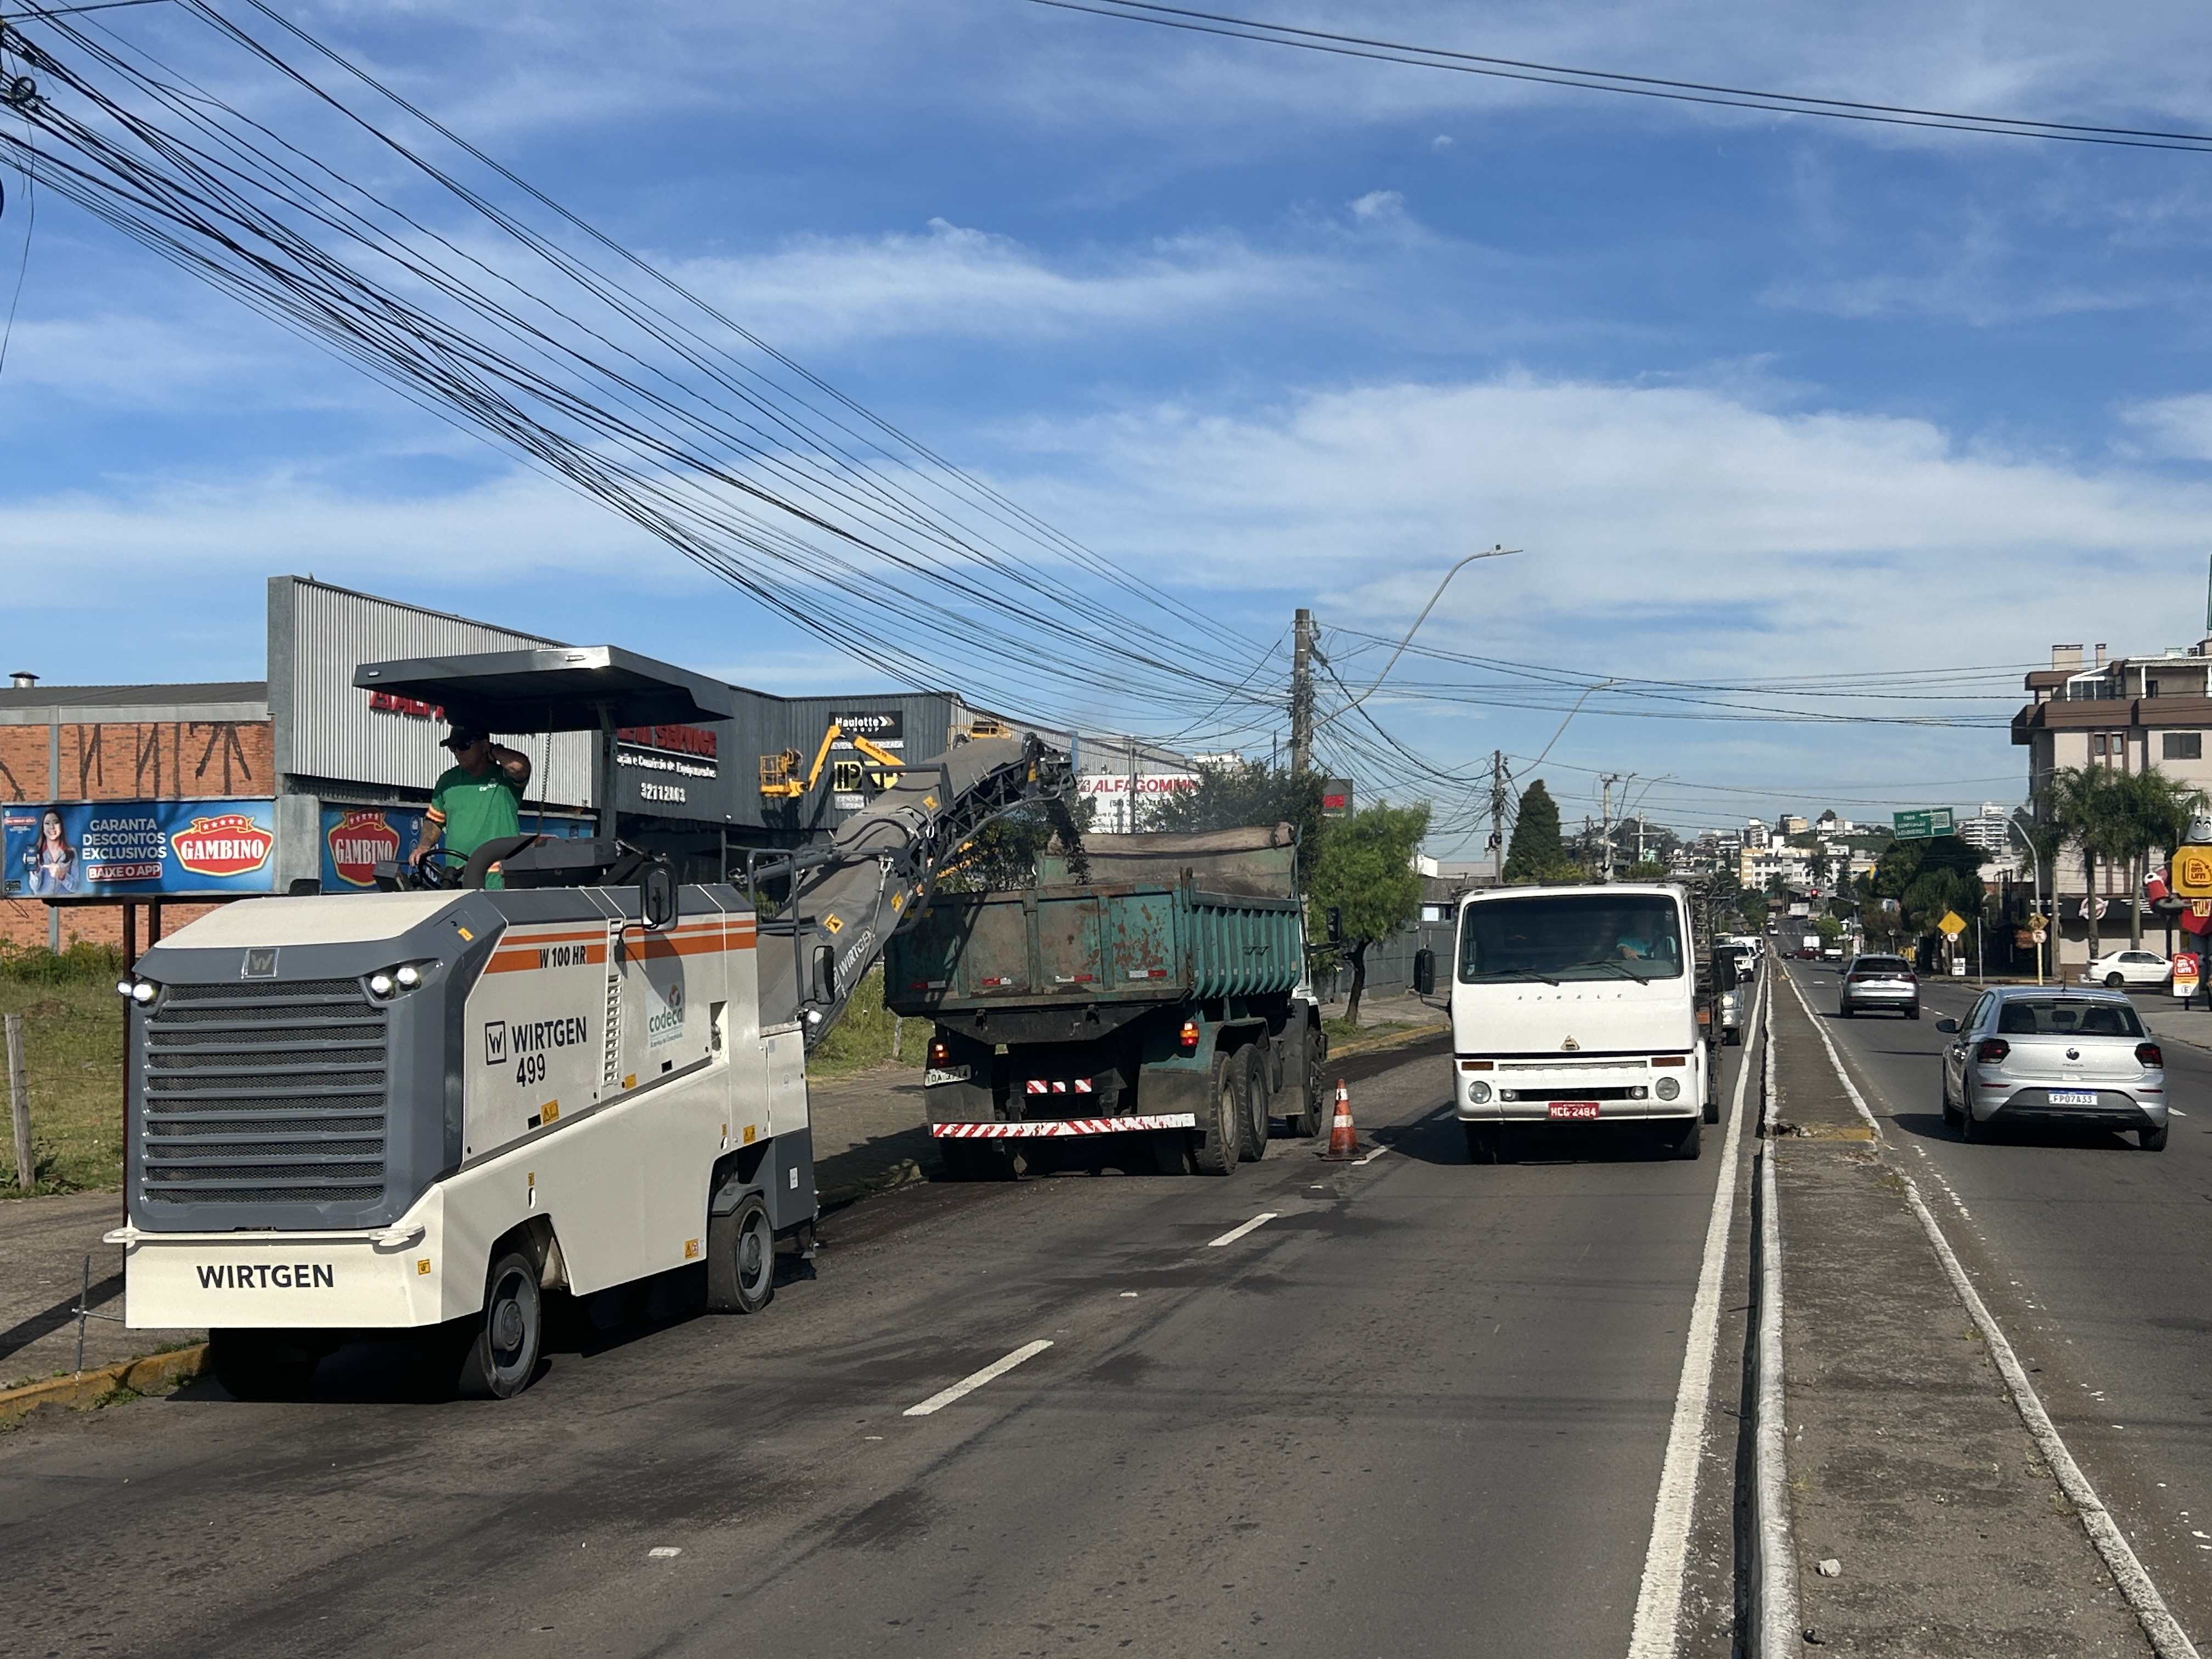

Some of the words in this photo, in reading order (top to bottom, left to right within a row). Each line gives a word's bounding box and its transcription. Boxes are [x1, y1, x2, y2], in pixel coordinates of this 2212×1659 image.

[836, 716, 879, 727] Haulotte
[90, 818, 157, 832] GARANTA
[83, 832, 166, 846] DESCONTOS
[180, 839, 264, 860] GAMBINO
[83, 846, 167, 860] EXCLUSIVOS
[335, 838, 393, 865] GAMBINO
[89, 866, 124, 878] BAIXE
[126, 866, 135, 876] O
[137, 865, 161, 876] APP
[539, 949, 550, 968] W
[552, 946, 569, 968] 100
[573, 945, 586, 966] HR
[838, 926, 876, 977] WIRTGEN
[650, 1006, 682, 1032] codeca
[489, 1031, 503, 1054] W
[512, 1016, 586, 1053] WIRTGEN
[517, 1053, 545, 1087] 499
[196, 1265, 334, 1289] WIRTGEN
